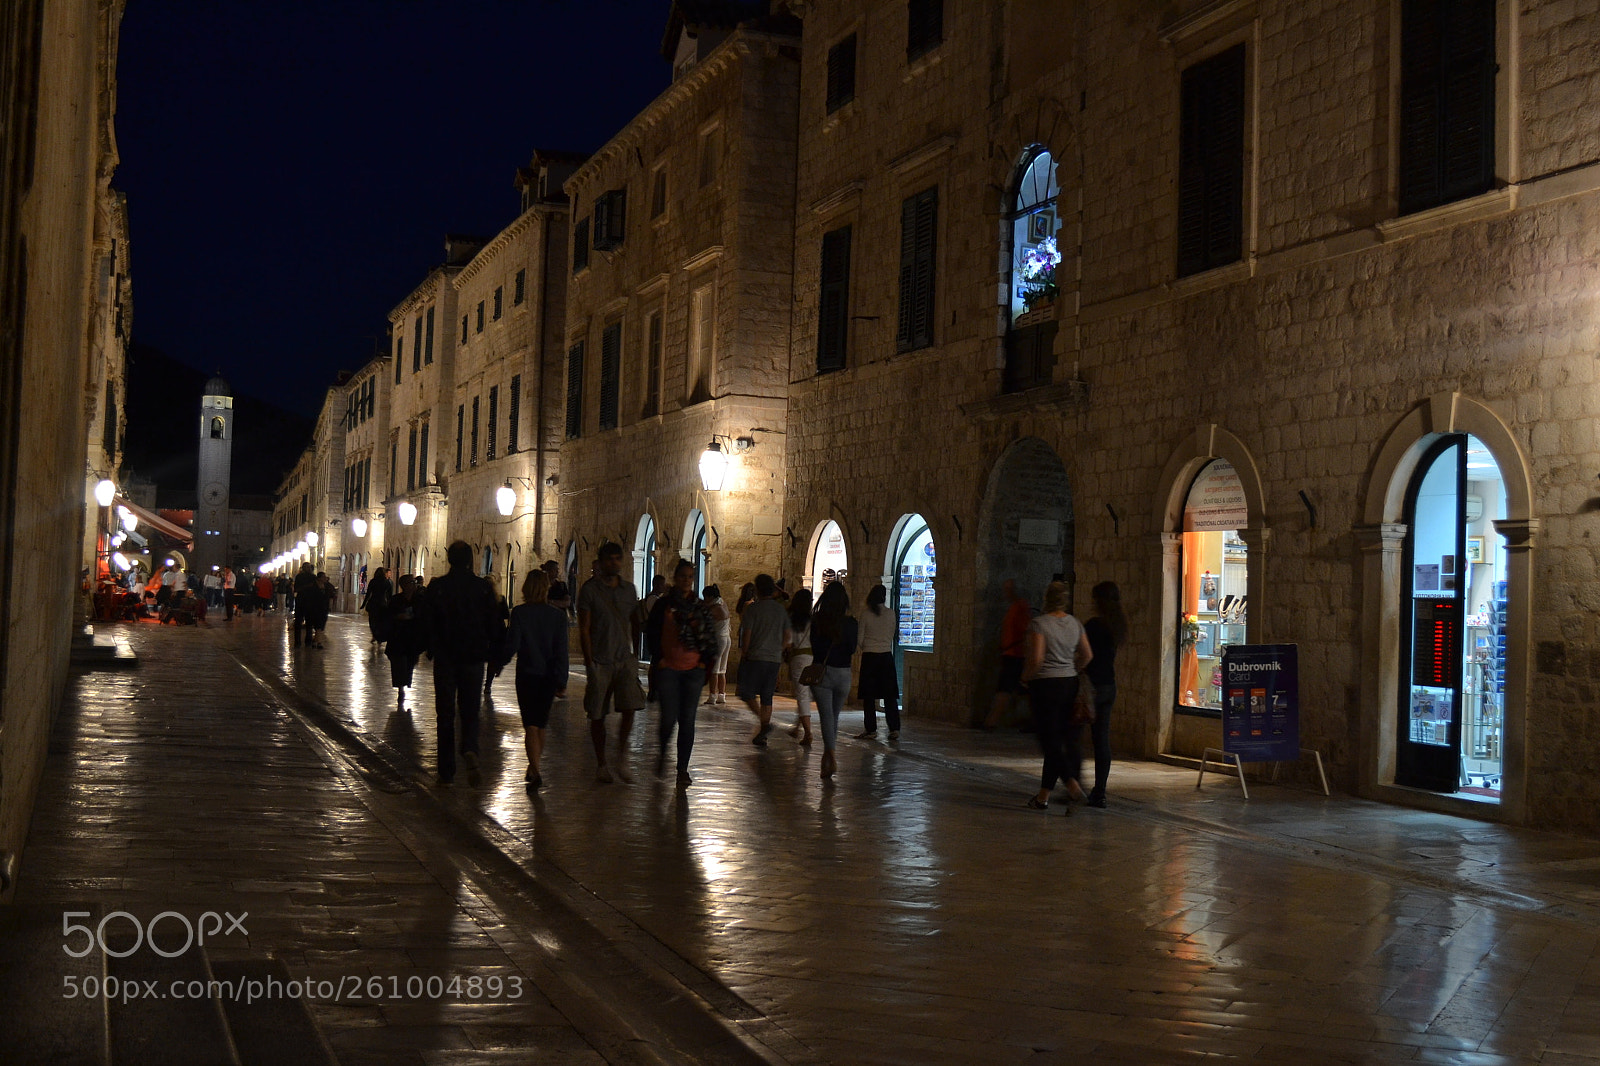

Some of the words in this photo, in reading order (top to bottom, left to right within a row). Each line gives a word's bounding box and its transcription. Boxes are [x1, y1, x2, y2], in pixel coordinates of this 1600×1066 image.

[1228, 661, 1281, 672] Dubrovnik
[1228, 671, 1251, 682] Card
[1229, 696, 1235, 706] 1
[1250, 695, 1258, 706] 3
[1272, 694, 1279, 705] 7
